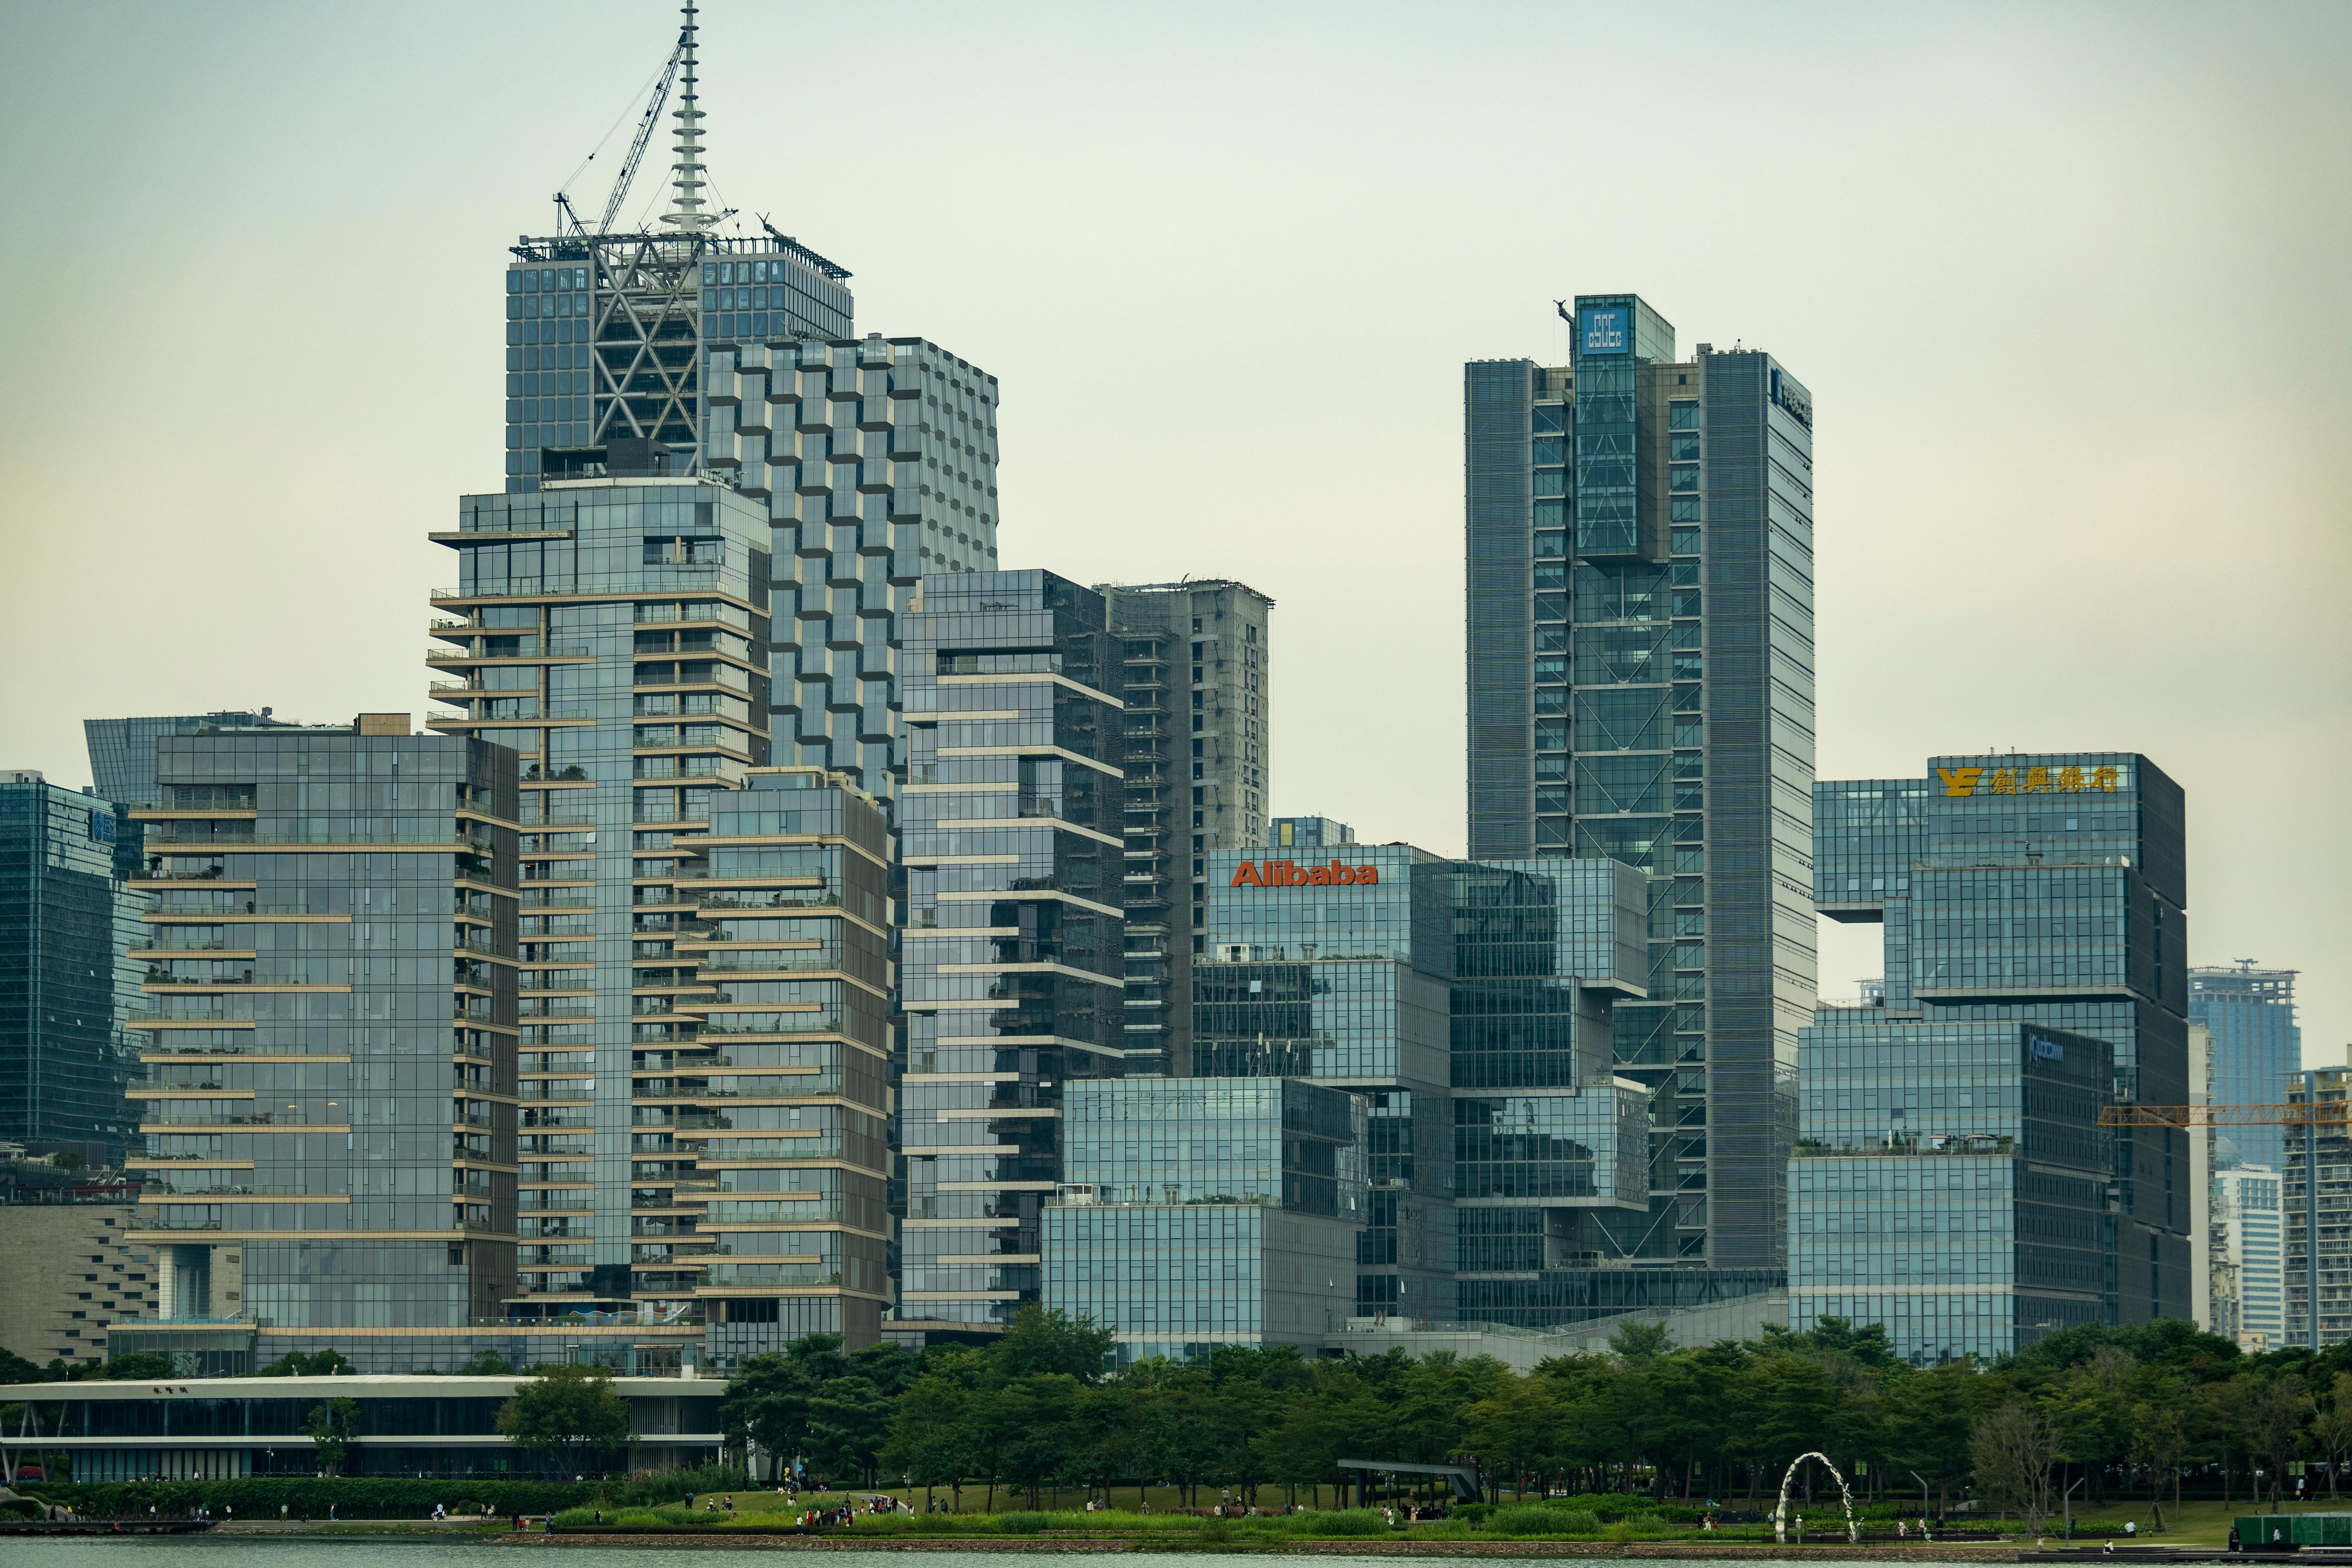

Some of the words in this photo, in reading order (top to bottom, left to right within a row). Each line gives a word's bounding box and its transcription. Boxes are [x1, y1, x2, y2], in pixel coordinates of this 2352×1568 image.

[1990, 765, 2120, 795] 創興銀行
[1230, 859, 1378, 887] Alibaba
